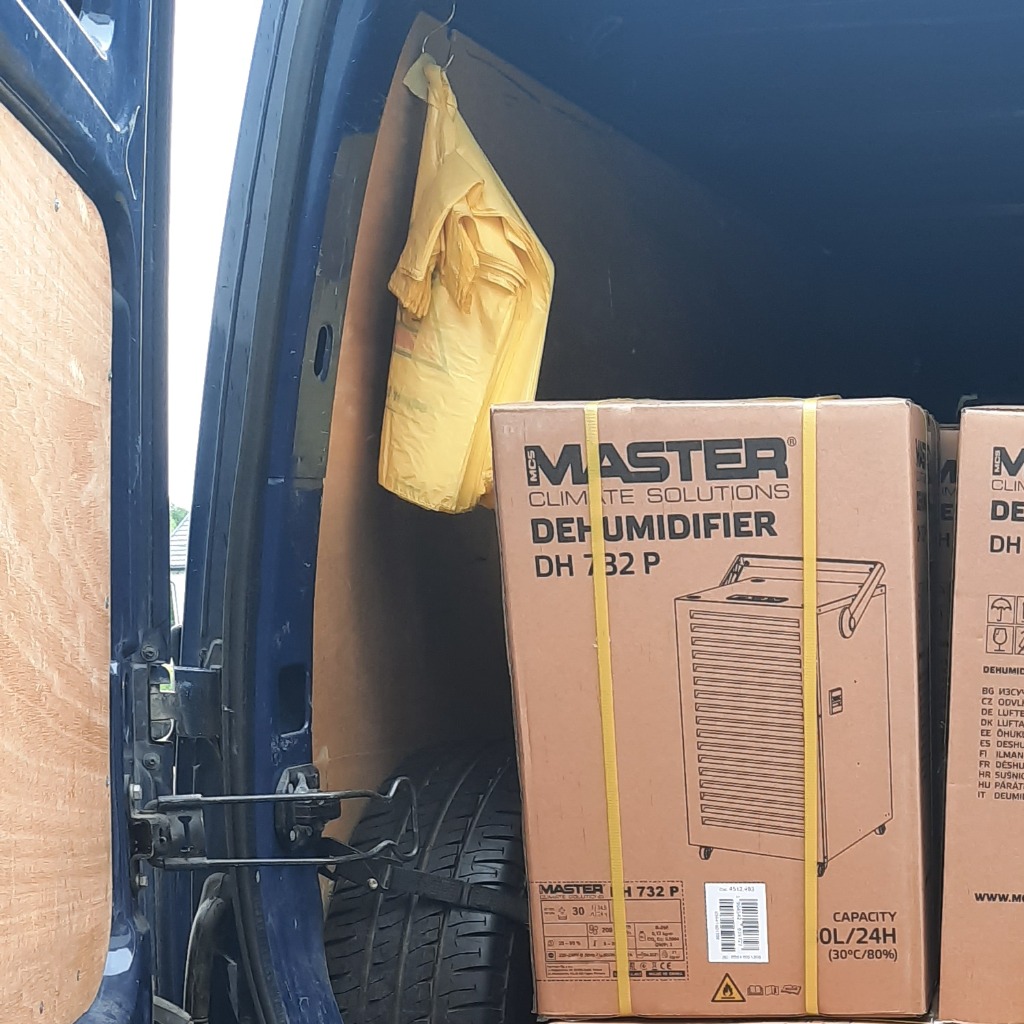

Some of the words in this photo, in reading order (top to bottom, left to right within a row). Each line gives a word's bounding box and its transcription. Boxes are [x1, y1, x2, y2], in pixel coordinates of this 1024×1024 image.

[528, 449, 539, 483] MCS
[534, 437, 789, 486] MASTER
[529, 489, 635, 507] CLIMTE
[647, 484, 791, 503] SOLUTIONS
[531, 511, 778, 544] DEHUMIDIFIER
[989, 535, 1021, 555] DH
[534, 554, 574, 578] DH
[643, 552, 661, 575] P
[981, 697, 993, 706] CZ
[981, 708, 993, 716] DE
[980, 718, 993, 726] DK
[980, 729, 991, 737] EE
[980, 739, 991, 748] ES
[979, 749, 987, 758] FI
[996, 750, 1024, 759] ILMAN
[978, 760, 991, 768] FR
[978, 770, 991, 778] HR
[977, 780, 991, 789] HU
[539, 884, 604, 894] MASTER
[636, 885, 665, 897] 732
[669, 886, 680, 897] P
[571, 906, 585, 916] 30
[832, 911, 898, 923] CAPACITY
[818, 927, 897, 945] 0L/24H
